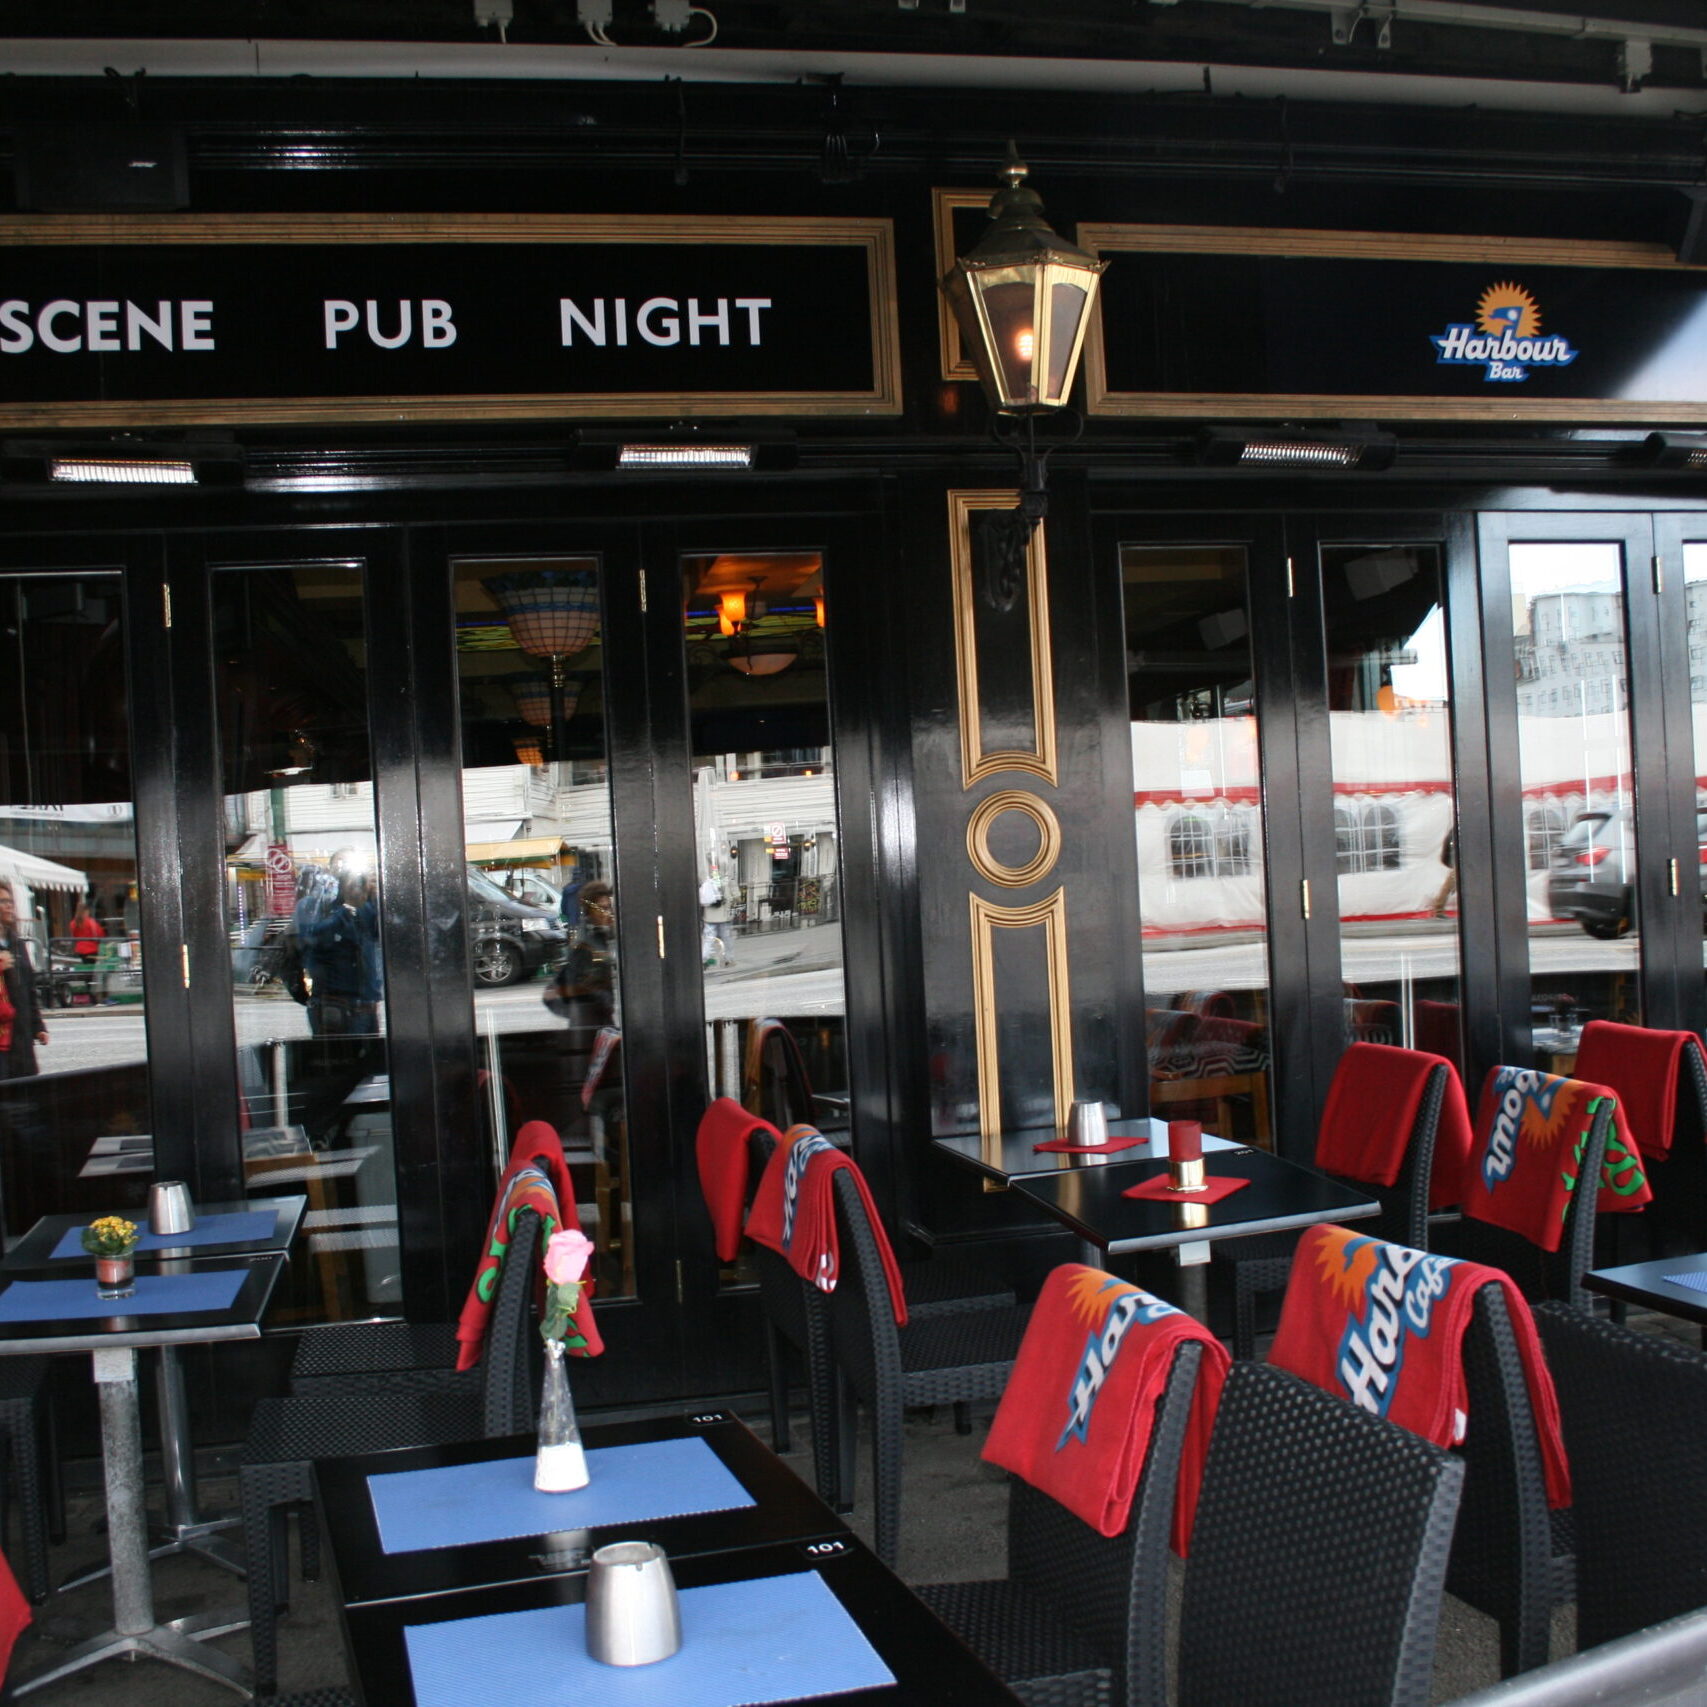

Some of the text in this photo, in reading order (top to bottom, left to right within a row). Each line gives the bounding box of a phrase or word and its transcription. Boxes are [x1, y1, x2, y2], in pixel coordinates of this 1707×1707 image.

[0, 297, 772, 353] SCENE PUB NIGHT
[1437, 327, 1571, 361] Harbour
[1489, 361, 1524, 379] Bar
[692, 1413, 723, 1423] 101
[807, 1540, 844, 1554] 101
